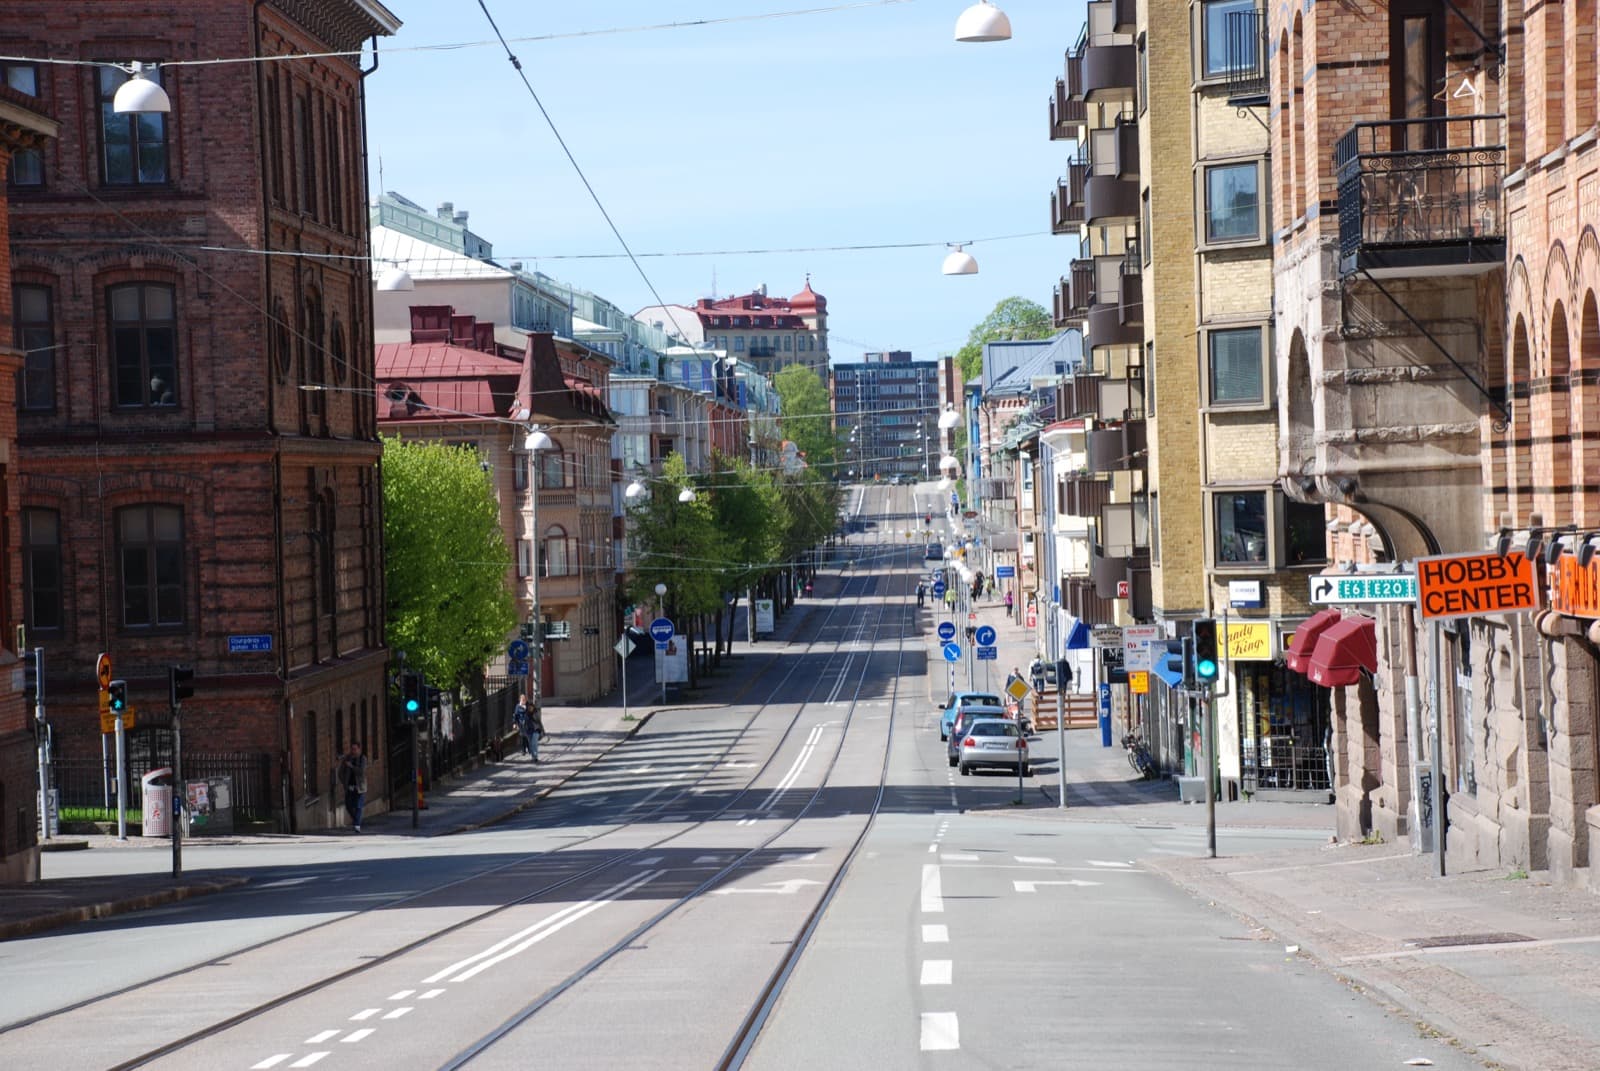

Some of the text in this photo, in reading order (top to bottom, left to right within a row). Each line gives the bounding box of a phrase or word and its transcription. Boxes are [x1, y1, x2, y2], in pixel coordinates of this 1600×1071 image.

[1424, 555, 1523, 585] HOBBY
[1344, 584, 1360, 595] E6
[1374, 583, 1402, 594] E20
[1425, 583, 1532, 615] CENTER
[1232, 638, 1265, 656] Kings
[1102, 689, 1109, 699] P
